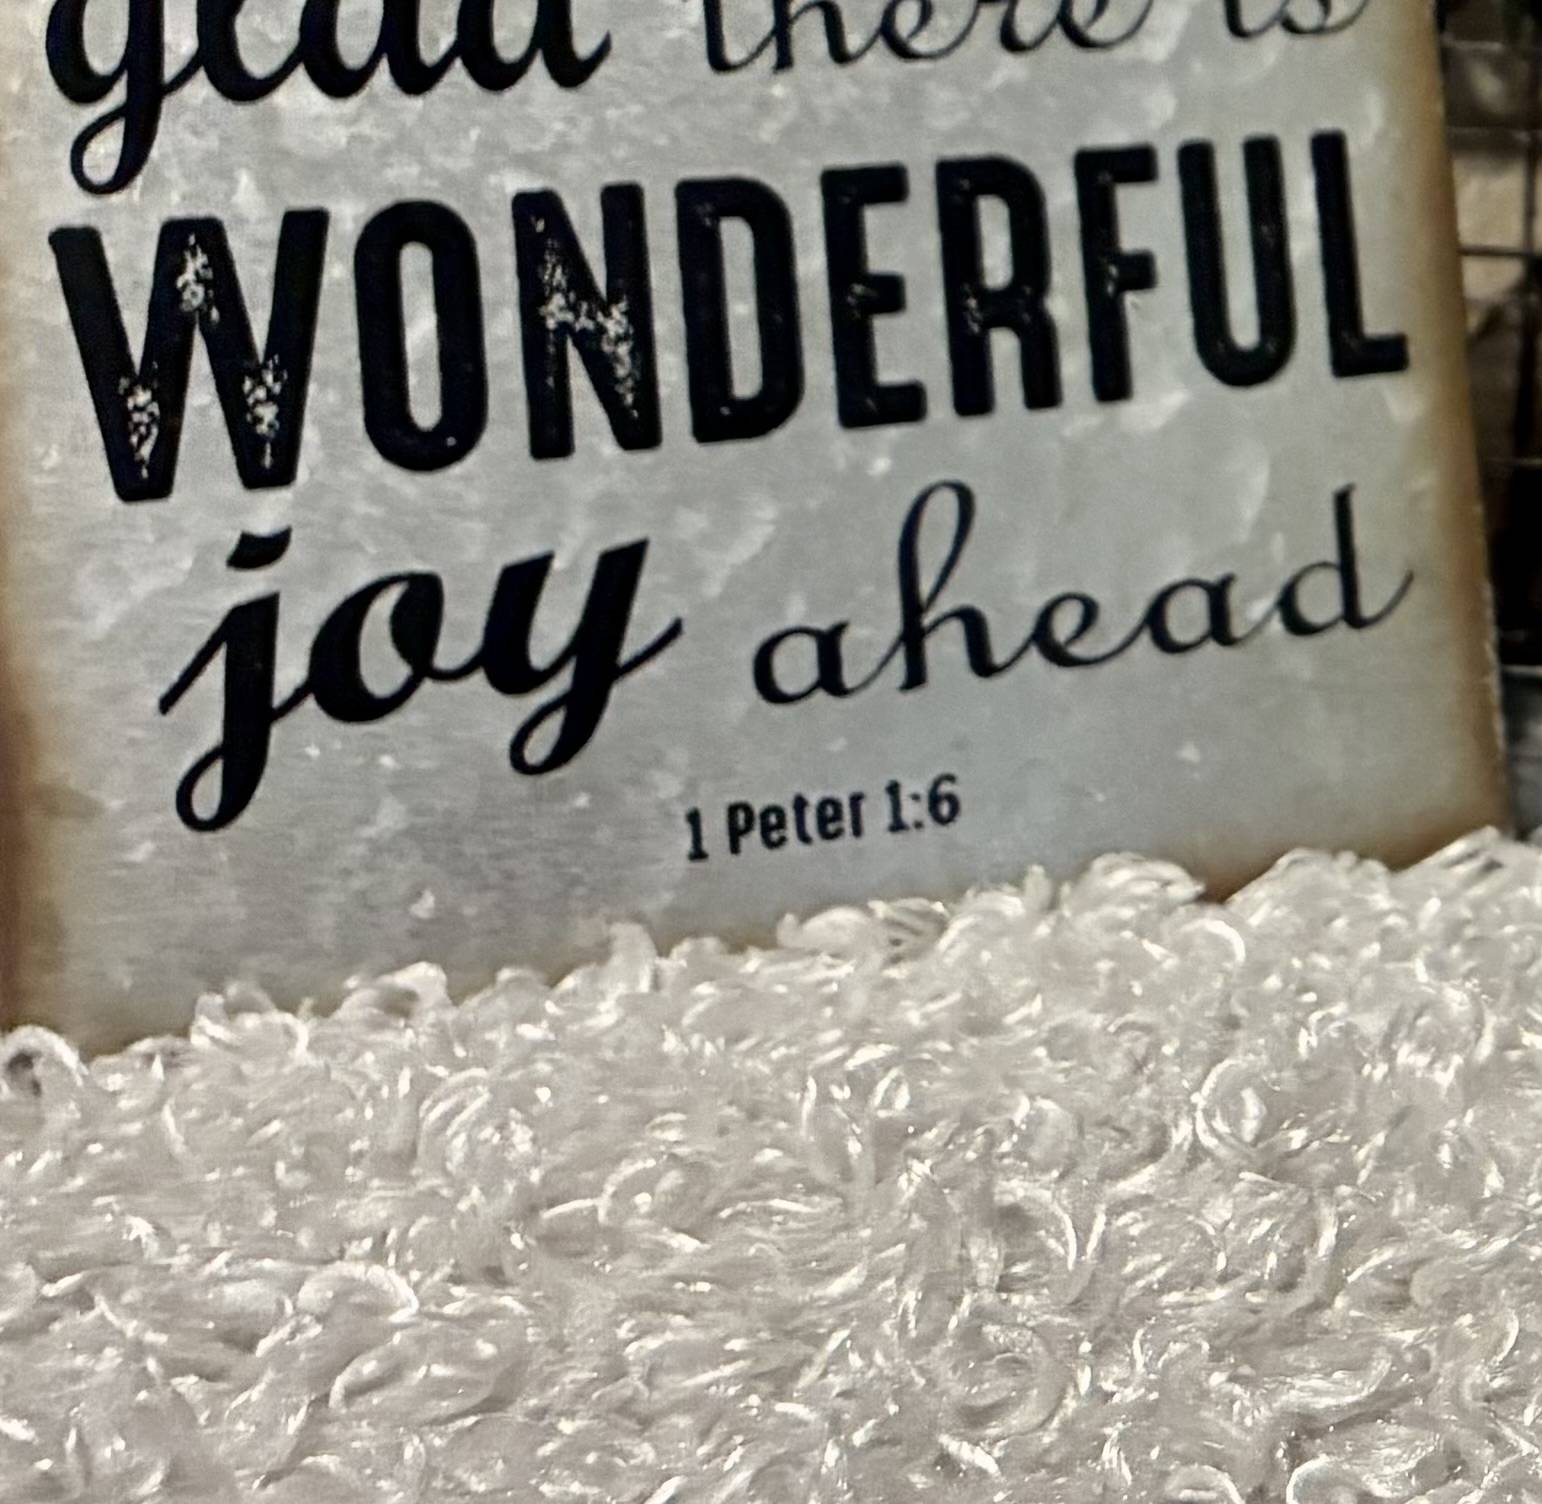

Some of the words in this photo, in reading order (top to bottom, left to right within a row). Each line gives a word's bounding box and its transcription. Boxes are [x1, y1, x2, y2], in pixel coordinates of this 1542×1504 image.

[46, 128, 1412, 505] WONDERFUL
[157, 525, 685, 835] joy
[750, 480, 1414, 707] ahead
[684, 806, 711, 863] 1
[725, 790, 868, 857] Peter
[884, 772, 962, 835] 1:6
